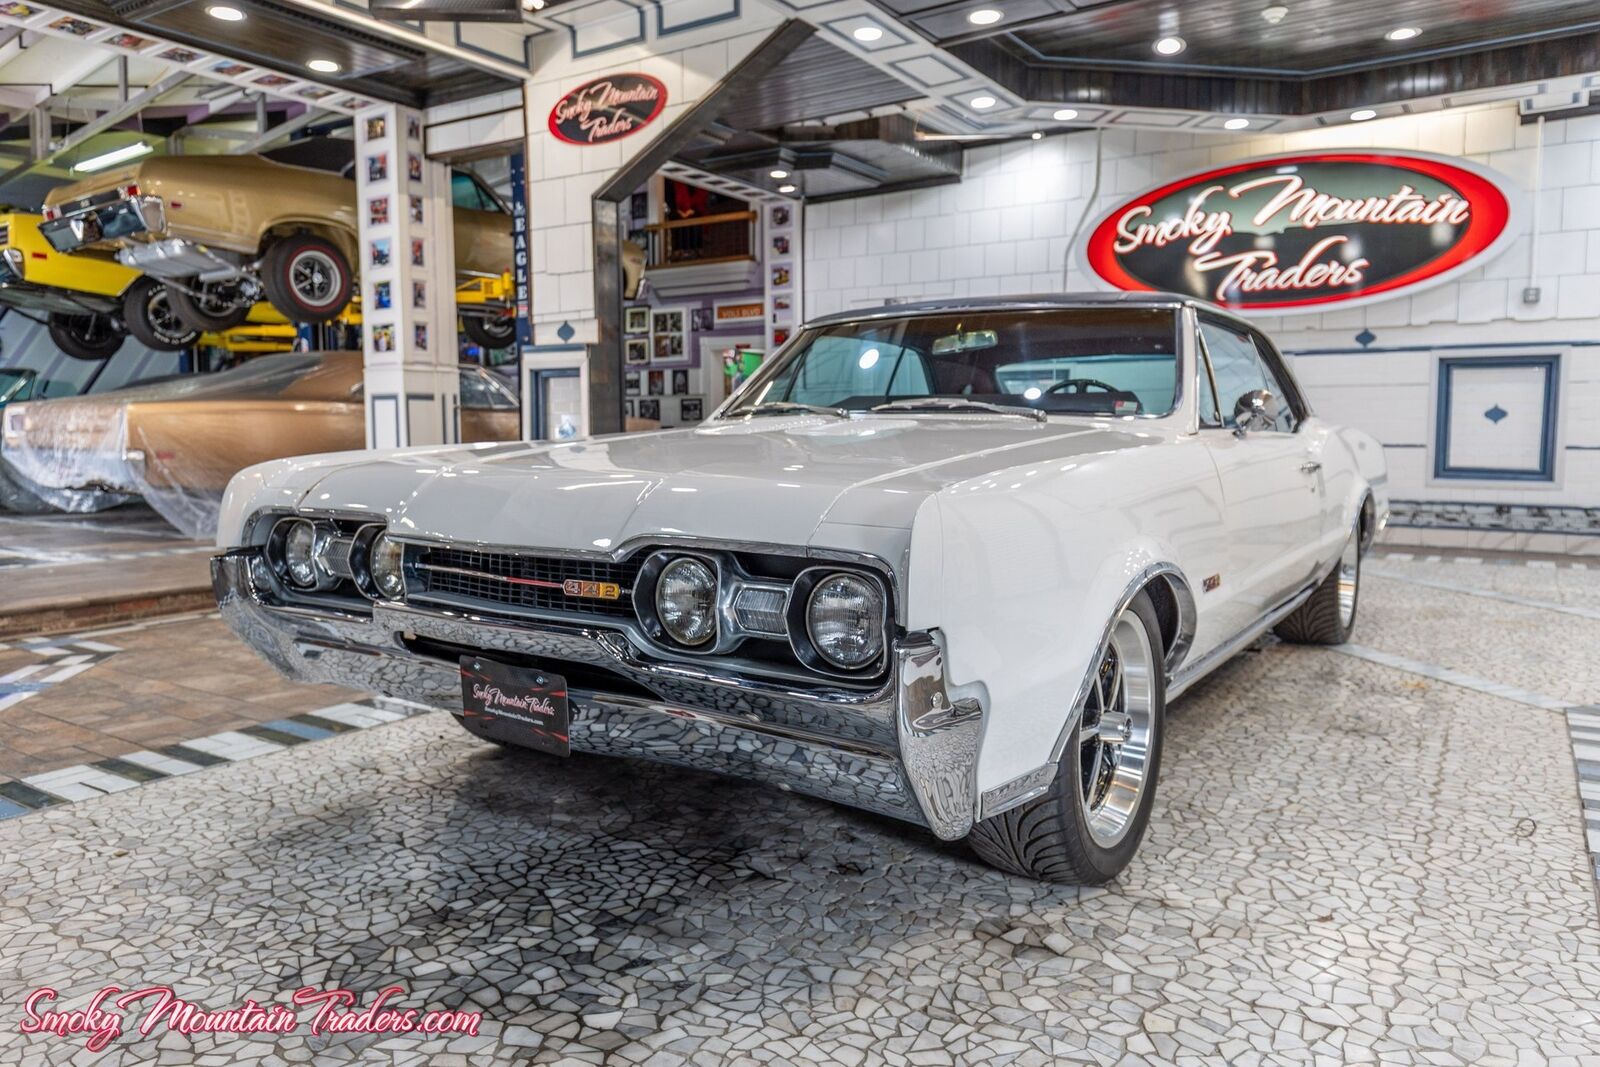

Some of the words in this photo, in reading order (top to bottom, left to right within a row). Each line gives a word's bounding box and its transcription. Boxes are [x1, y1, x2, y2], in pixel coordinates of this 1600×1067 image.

[556, 88, 592, 124] Smoky
[589, 81, 659, 107] Mountain
[580, 107, 633, 142] Traders
[1114, 185, 1232, 255] Smoky
[1228, 174, 1470, 229] Mountain
[1193, 235, 1370, 301] Traders
[565, 580, 617, 598] 442
[473, 683, 493, 706] Smoky
[489, 687, 528, 709] Mountain
[524, 695, 555, 716] Traders
